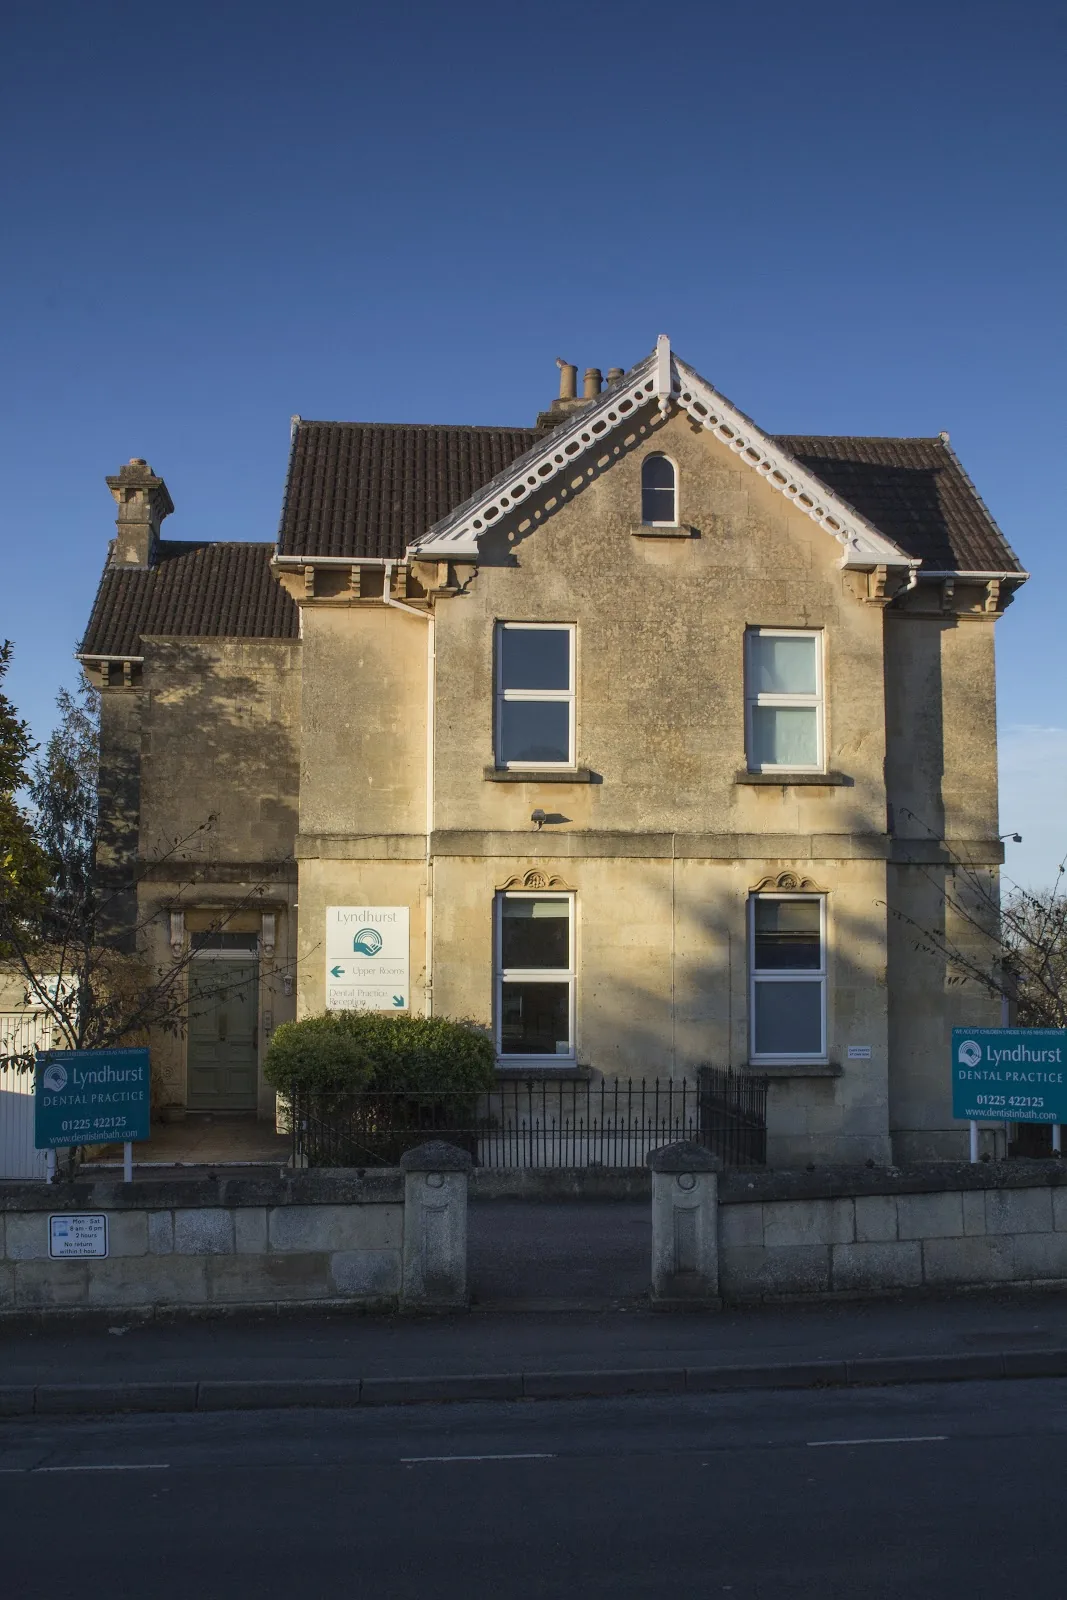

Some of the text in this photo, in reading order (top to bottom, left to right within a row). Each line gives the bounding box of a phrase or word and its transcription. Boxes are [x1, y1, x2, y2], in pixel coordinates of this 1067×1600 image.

[337, 910, 397, 925] Lyndhurst
[352, 967, 405, 976] Upper Rooms
[329, 989, 355, 997] Dental
[329, 998, 366, 1006] Reception
[986, 1044, 1062, 1067] Lyndhurst
[73, 1065, 144, 1089] Lyndhurst
[959, 1070, 1063, 1083] DENTAL PRACTICE
[43, 1091, 144, 1107] DENTAL PRACTICE
[976, 1094, 1044, 1107] 01225 422125
[965, 1107, 1057, 1120] www.dentistinbath.com
[61, 1116, 127, 1131] 01225 422125
[49, 1129, 138, 1143] www.dentistinbath.com
